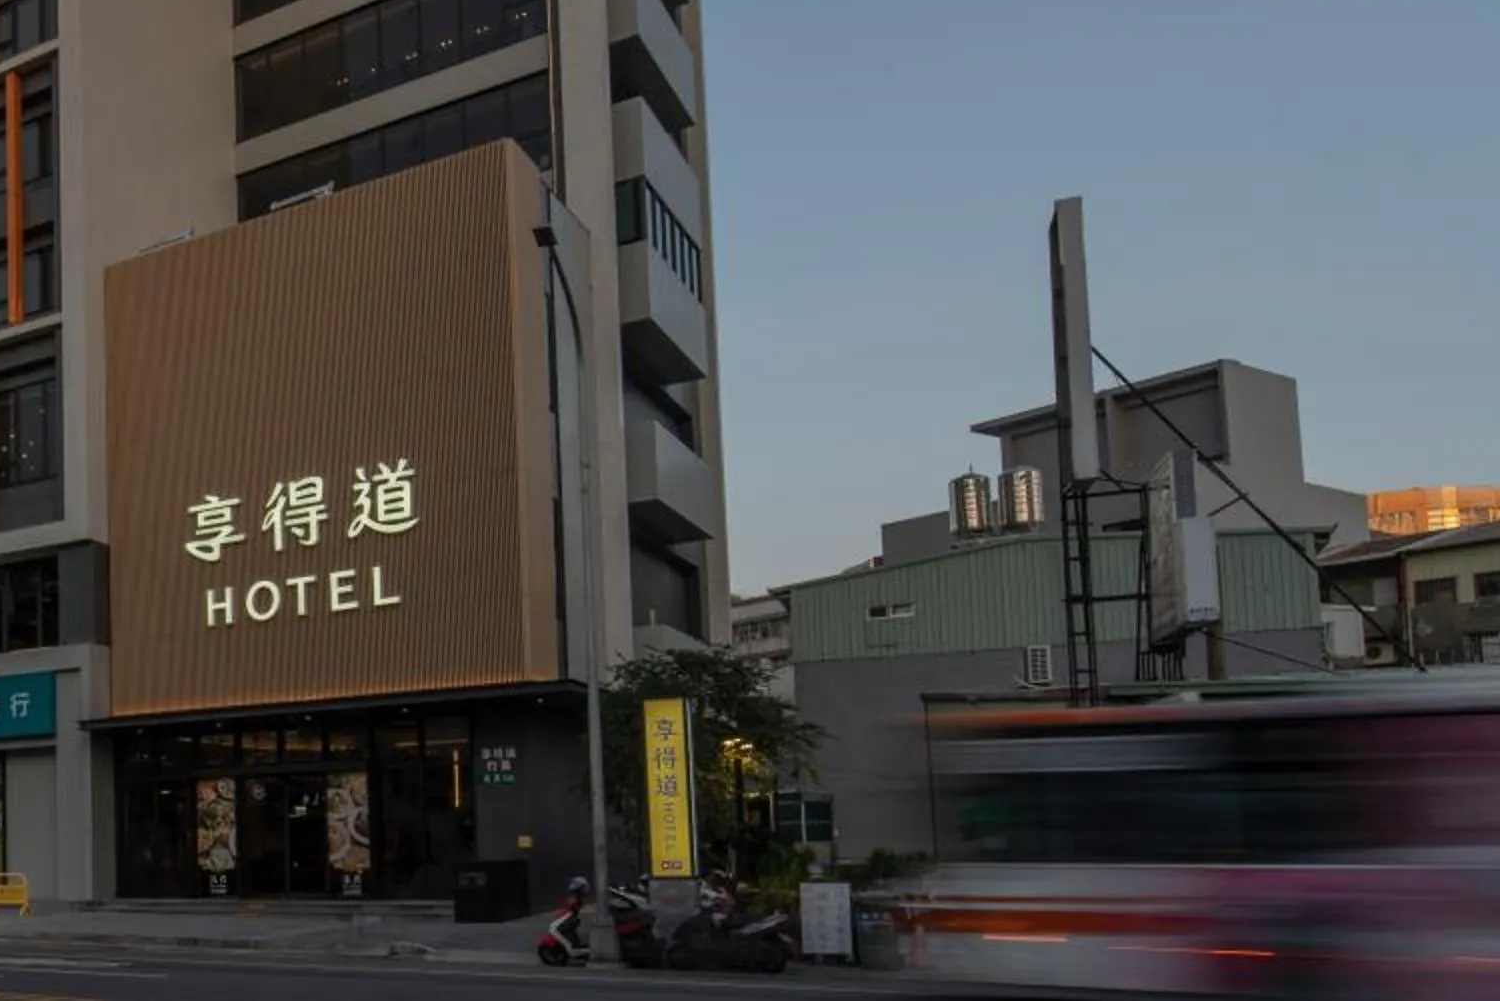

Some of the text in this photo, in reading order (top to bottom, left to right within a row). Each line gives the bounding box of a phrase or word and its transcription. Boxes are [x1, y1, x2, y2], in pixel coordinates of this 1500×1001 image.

[185, 458, 420, 562] 享得道
[206, 566, 401, 627] HOTEL
[653, 718, 679, 797] 享得道
